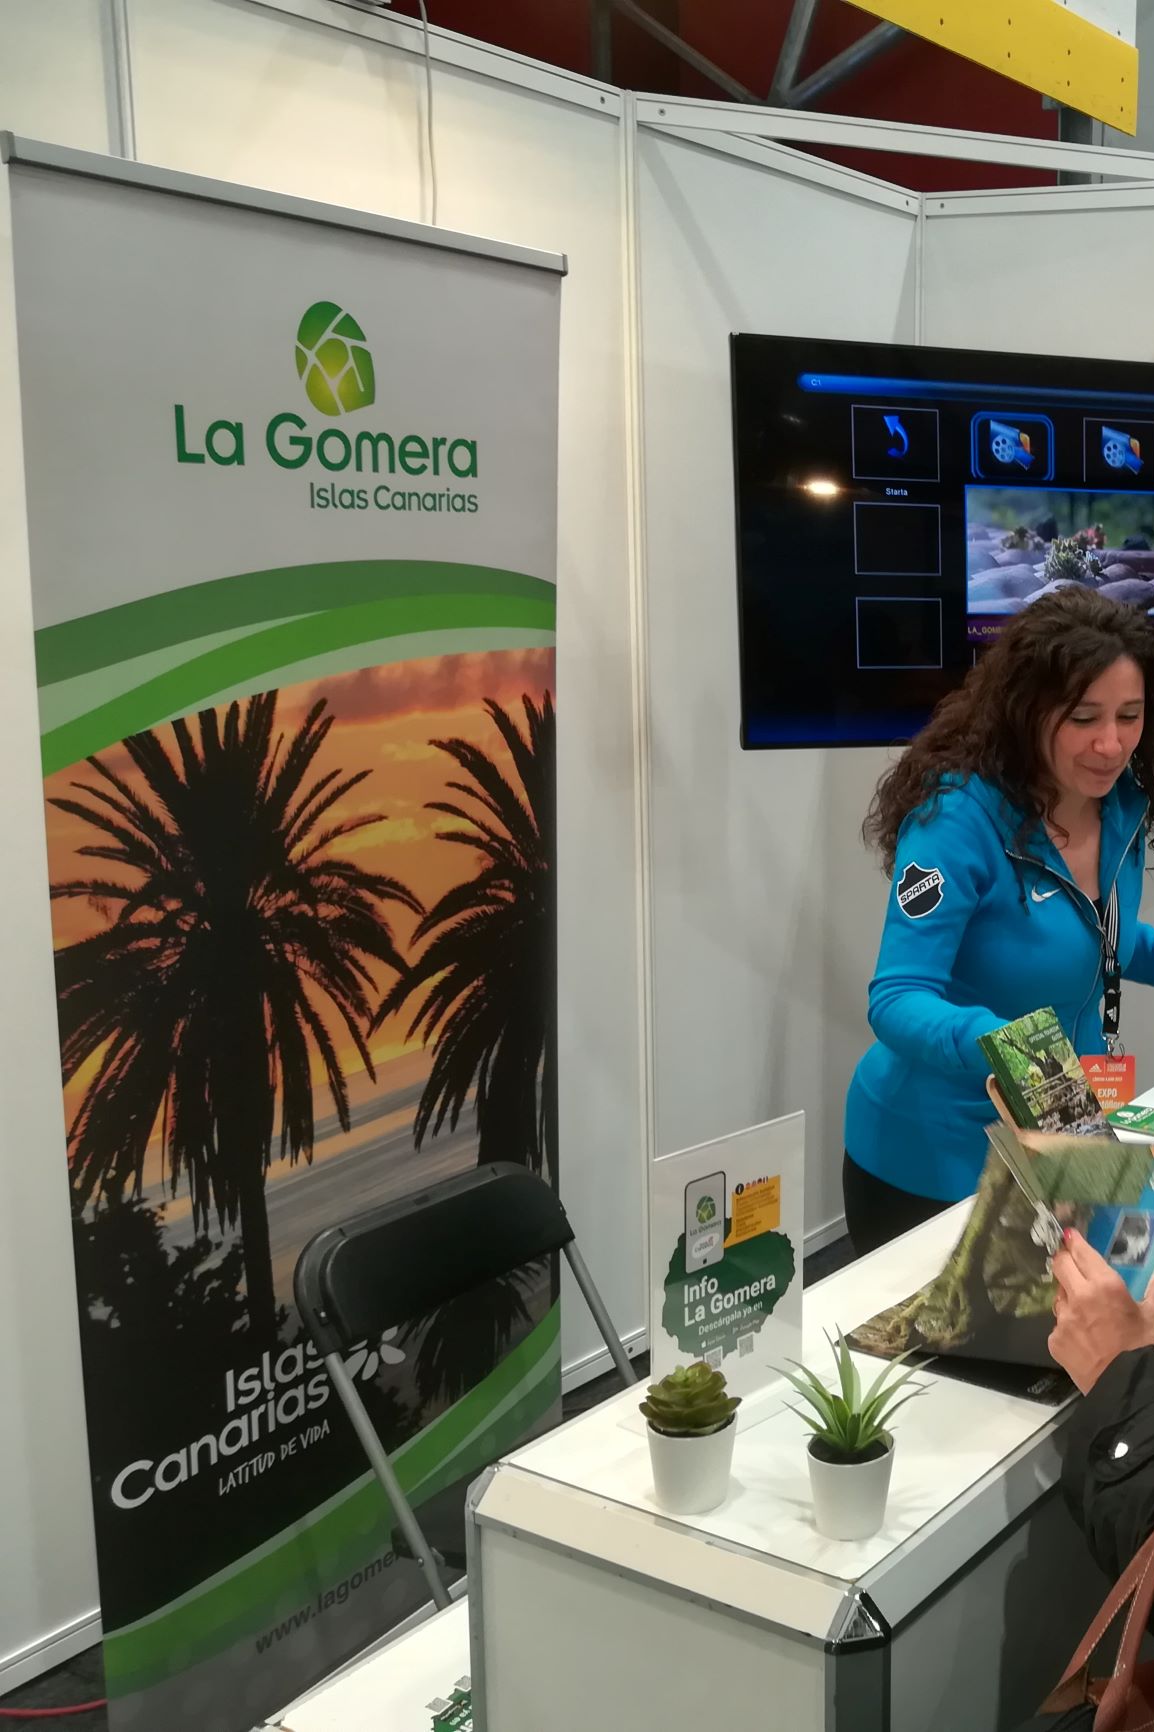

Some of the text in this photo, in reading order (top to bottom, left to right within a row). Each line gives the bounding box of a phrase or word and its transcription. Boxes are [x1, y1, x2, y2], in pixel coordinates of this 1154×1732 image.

[174, 404, 478, 478] La Gomera
[310, 482, 479, 513] Islas Canarias
[900, 873, 940, 904] SPARTA
[1097, 1088, 1117, 1098] EXPO
[684, 1275, 719, 1305] Info
[684, 1274, 776, 1327] La Gomera
[698, 1301, 763, 1336] Descárgala ya en
[226, 1339, 324, 1413] Islas
[111, 1373, 330, 1509] Canarias
[280, 1437, 297, 1461] DE
[299, 1418, 331, 1449] VIDA
